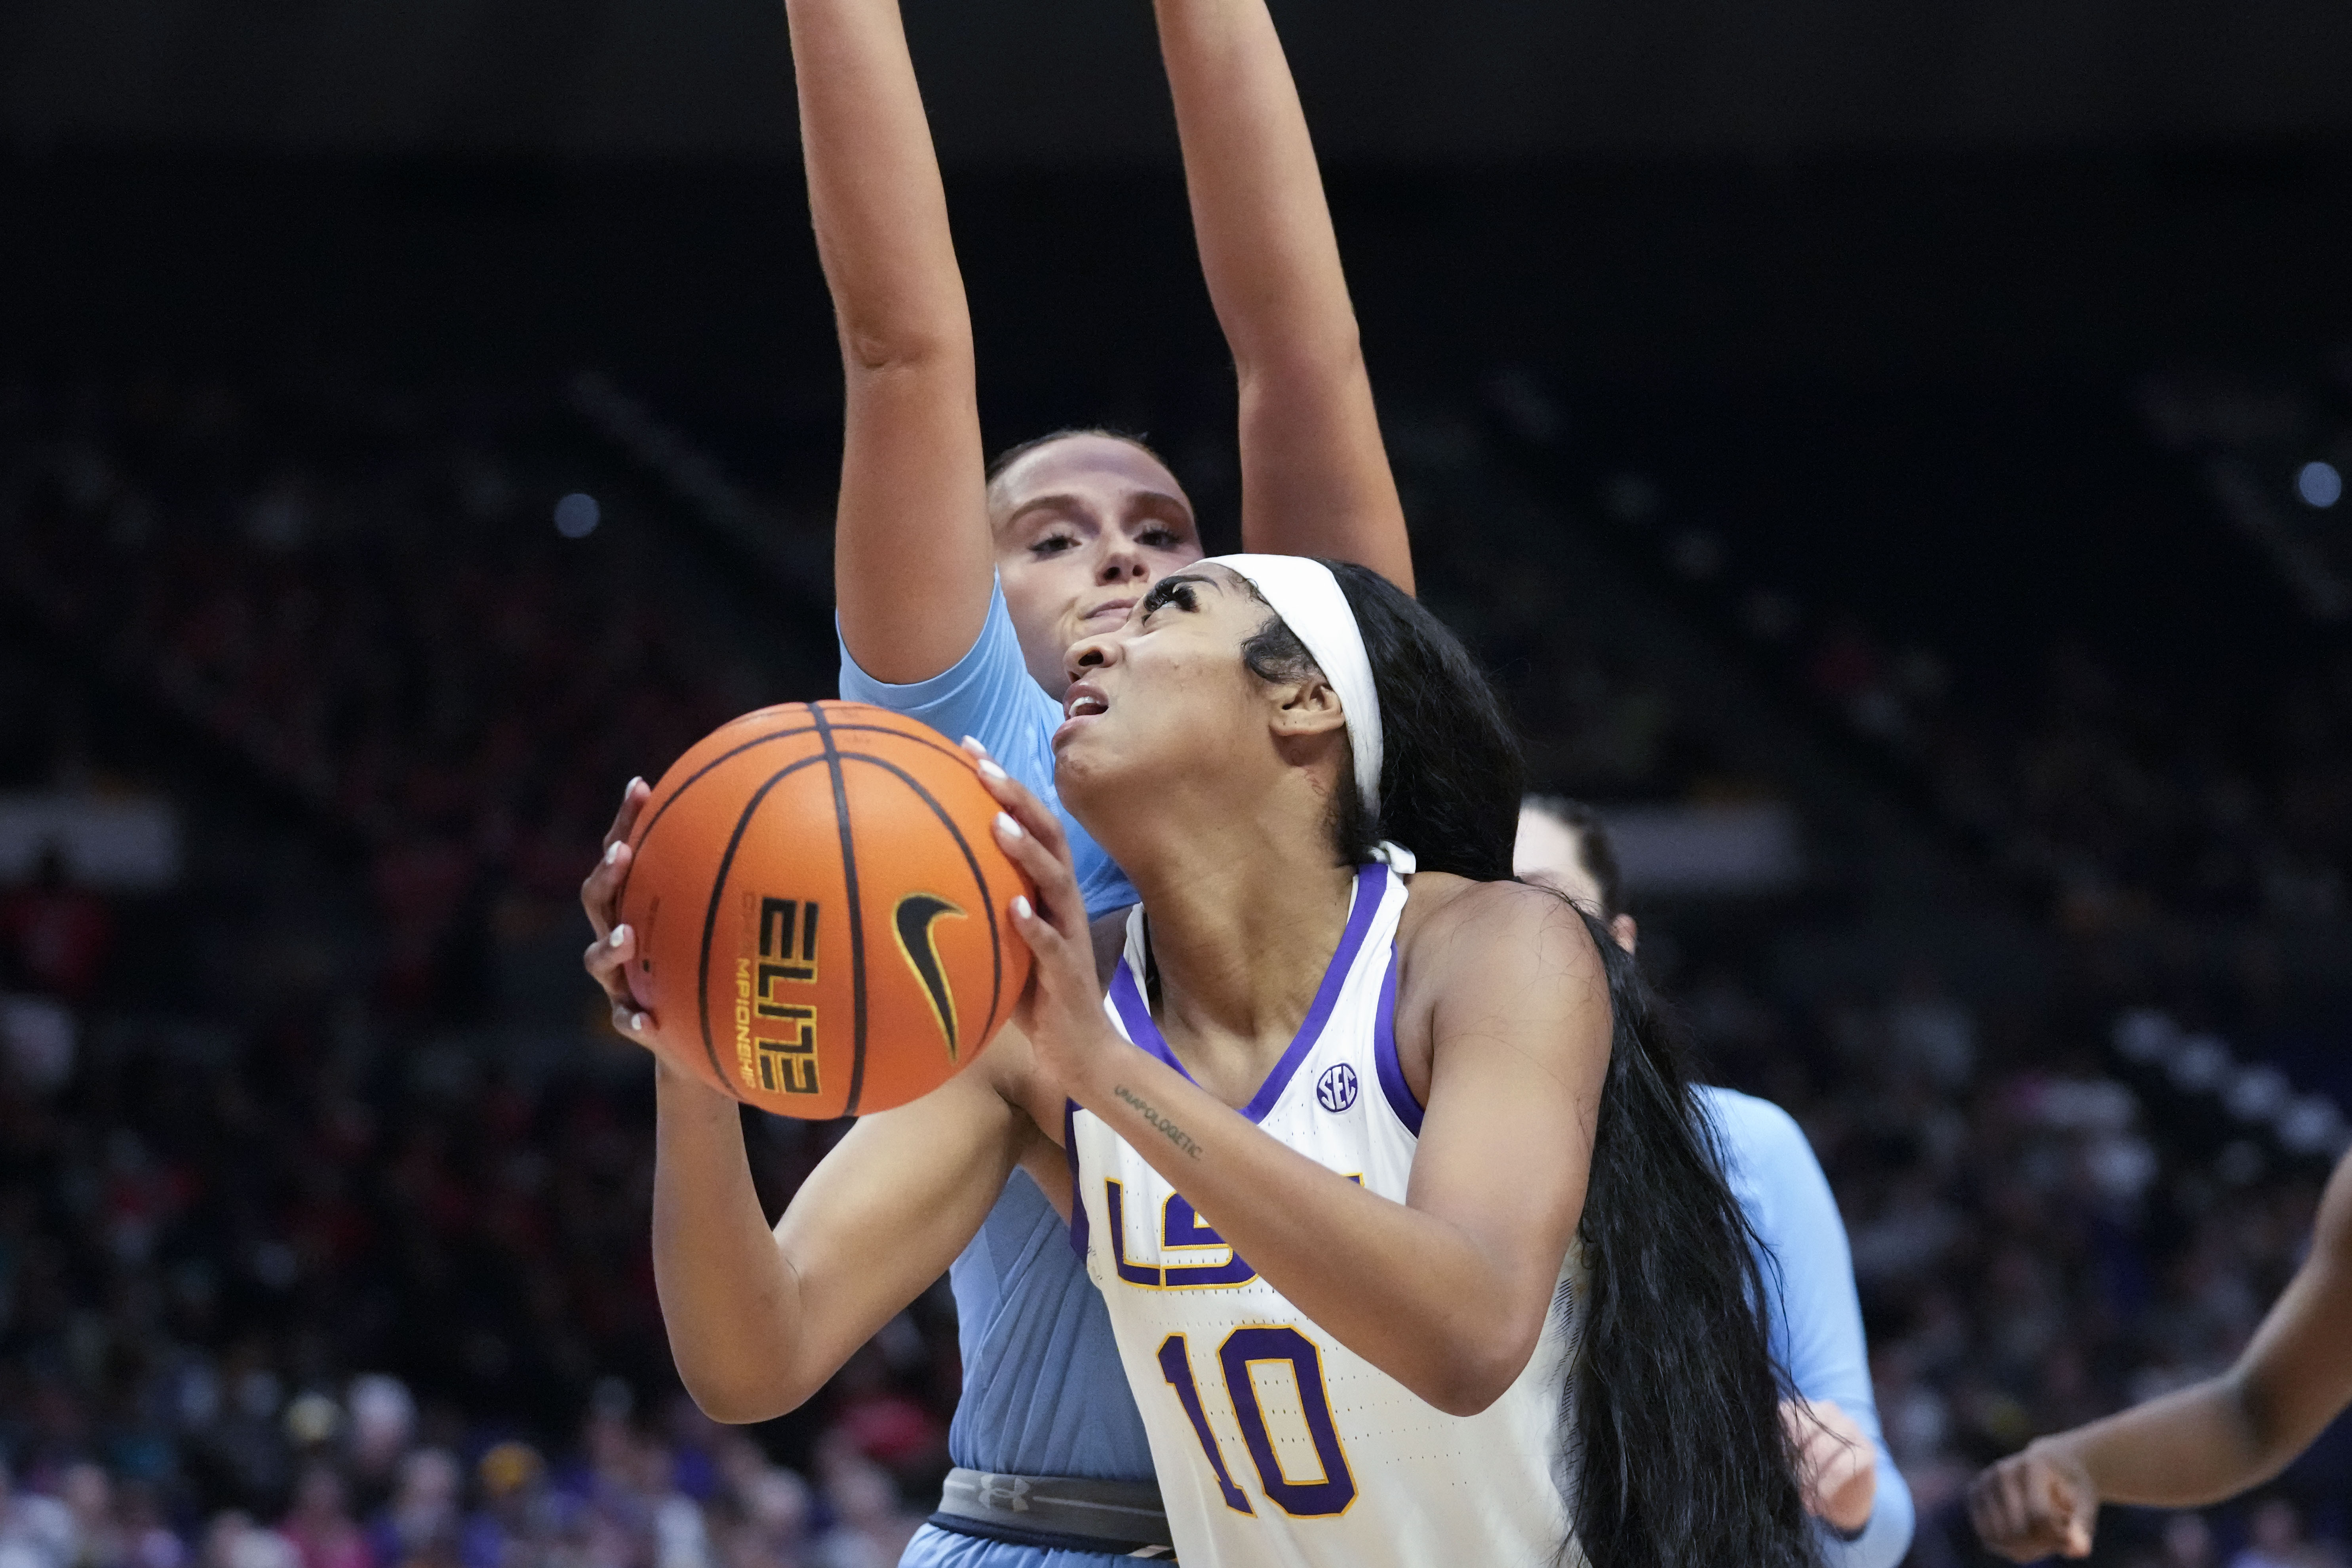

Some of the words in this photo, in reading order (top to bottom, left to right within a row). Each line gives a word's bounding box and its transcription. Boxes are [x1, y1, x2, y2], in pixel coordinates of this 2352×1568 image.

[736, 893, 753, 1089] CMPIONSHIP
[756, 896, 822, 1094] ELITE
[1319, 1064, 1357, 1112] SEC
[1155, 1324, 1359, 1519] 10
